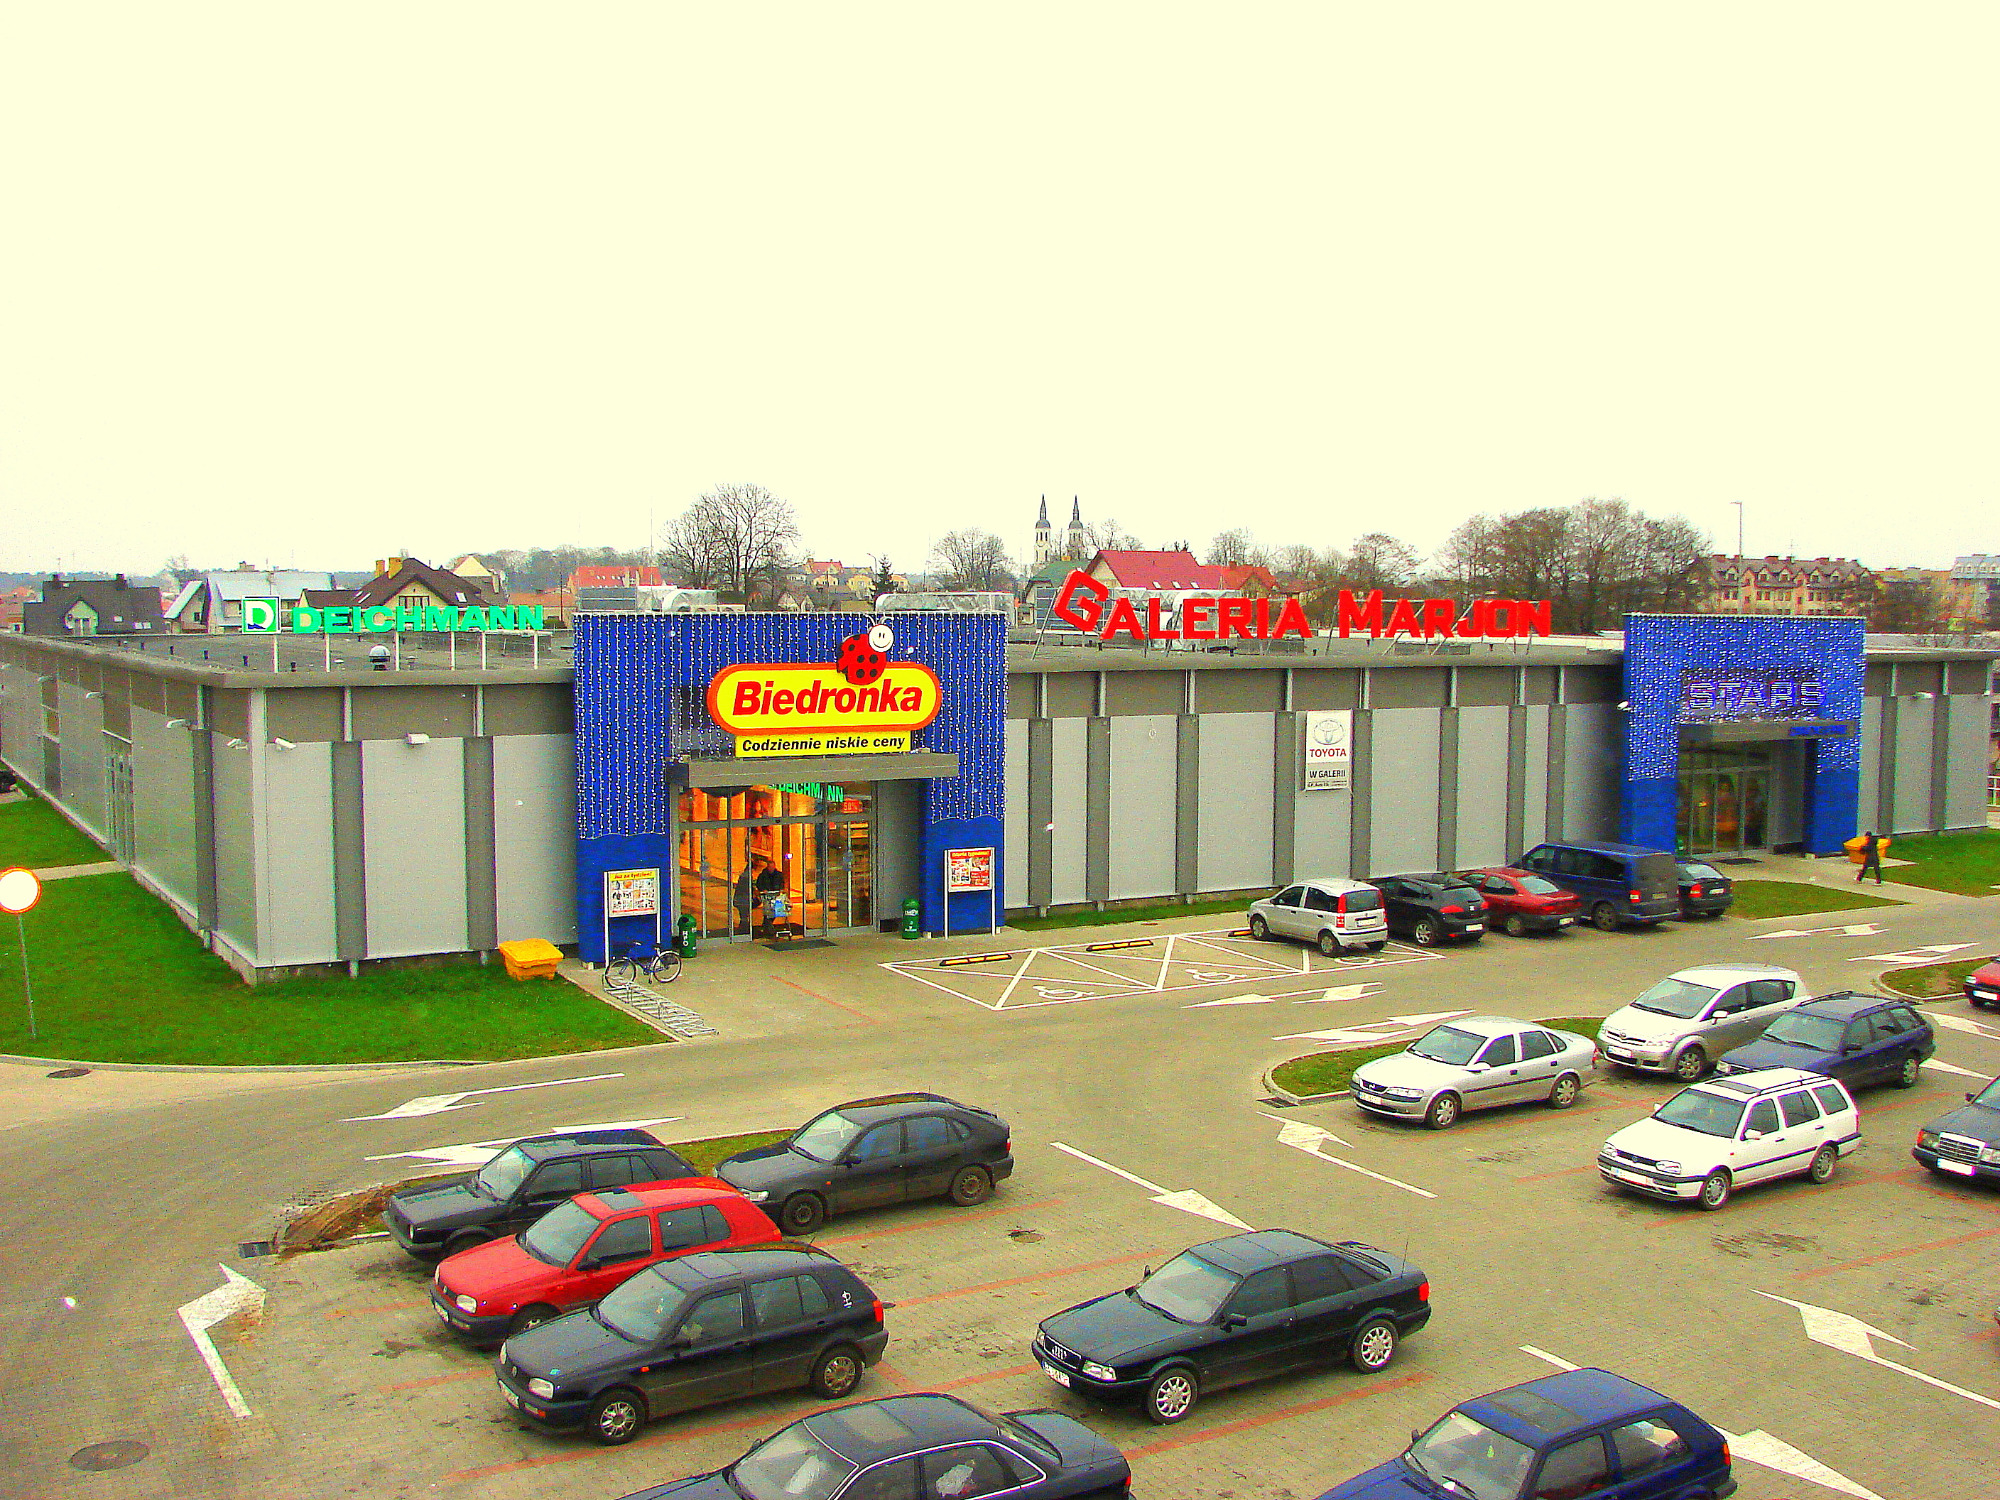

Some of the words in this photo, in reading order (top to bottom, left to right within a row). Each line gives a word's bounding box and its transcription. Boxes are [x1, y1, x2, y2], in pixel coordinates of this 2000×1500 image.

[1053, 570, 1312, 640] GALERIA
[1338, 589, 1551, 638] MARJON
[291, 605, 544, 634] DEICHMANN
[733, 679, 923, 715] Biedronka
[1689, 681, 1826, 709] STARS
[742, 738, 821, 753] Codziennie
[826, 737, 869, 749] niskie
[873, 736, 906, 750] ceny
[1309, 748, 1347, 757] TOYOTA
[1309, 770, 1318, 779] W
[778, 782, 844, 803] DEICHMNN
